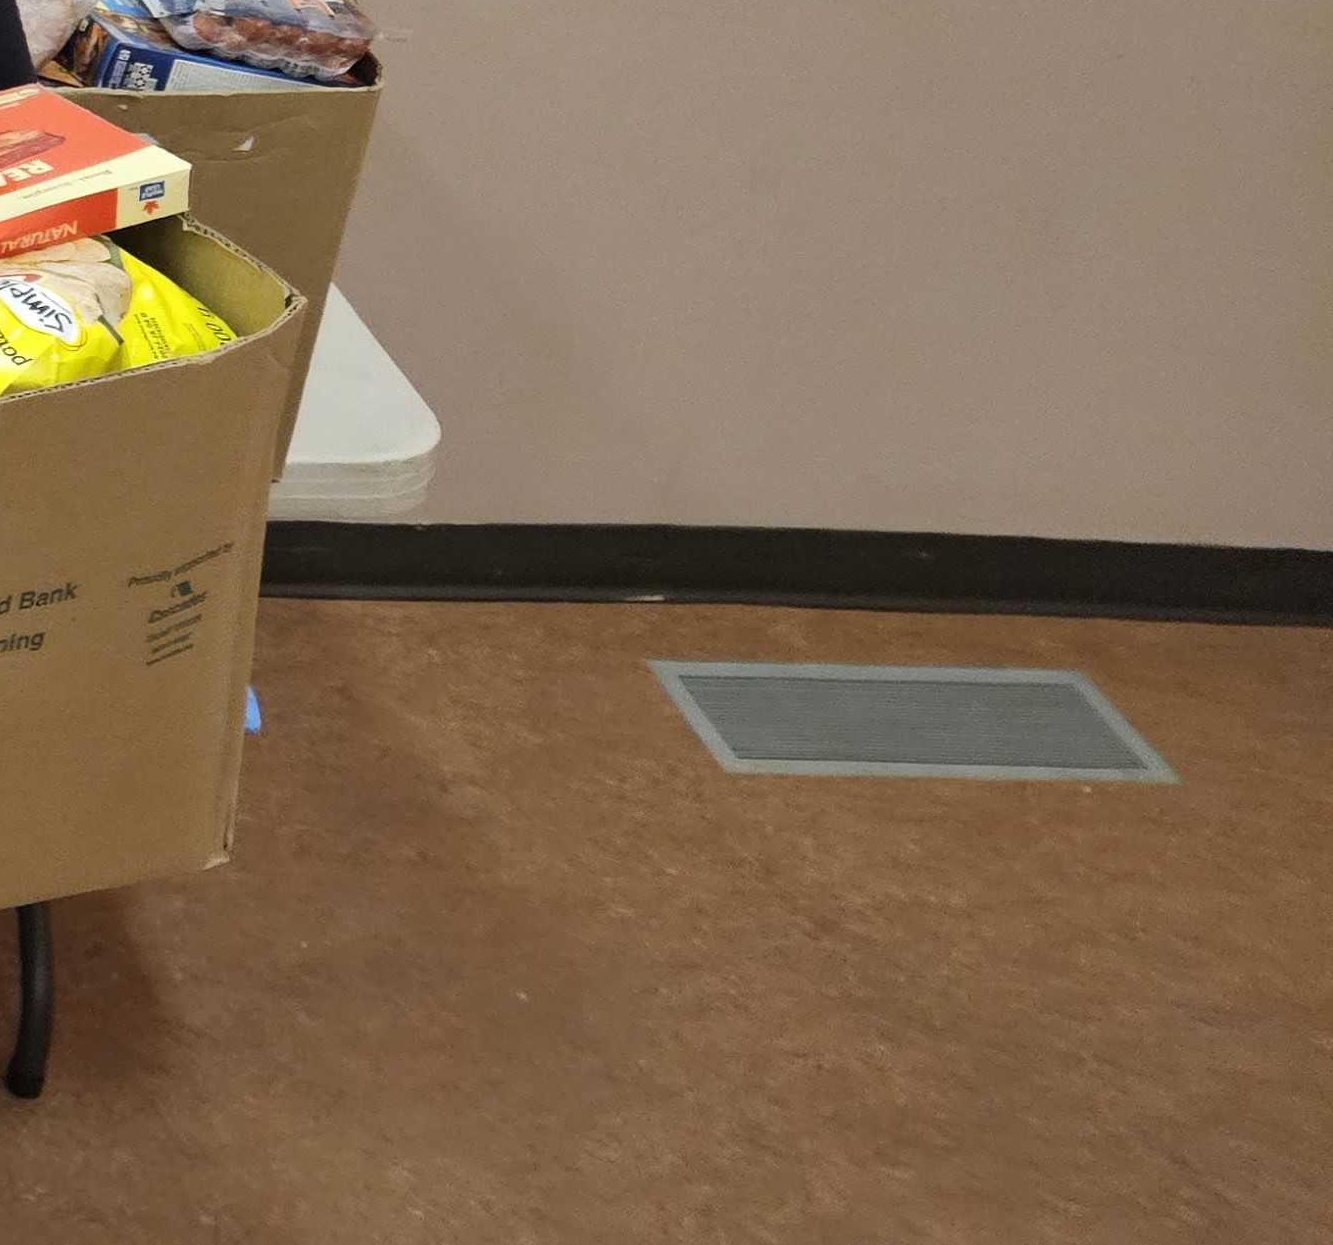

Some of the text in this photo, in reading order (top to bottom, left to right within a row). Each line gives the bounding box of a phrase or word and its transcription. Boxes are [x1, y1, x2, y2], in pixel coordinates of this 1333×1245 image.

[1, 220, 78, 253] NATURAL
[206, 322, 231, 346] 00
[18, 582, 78, 610] Bank
